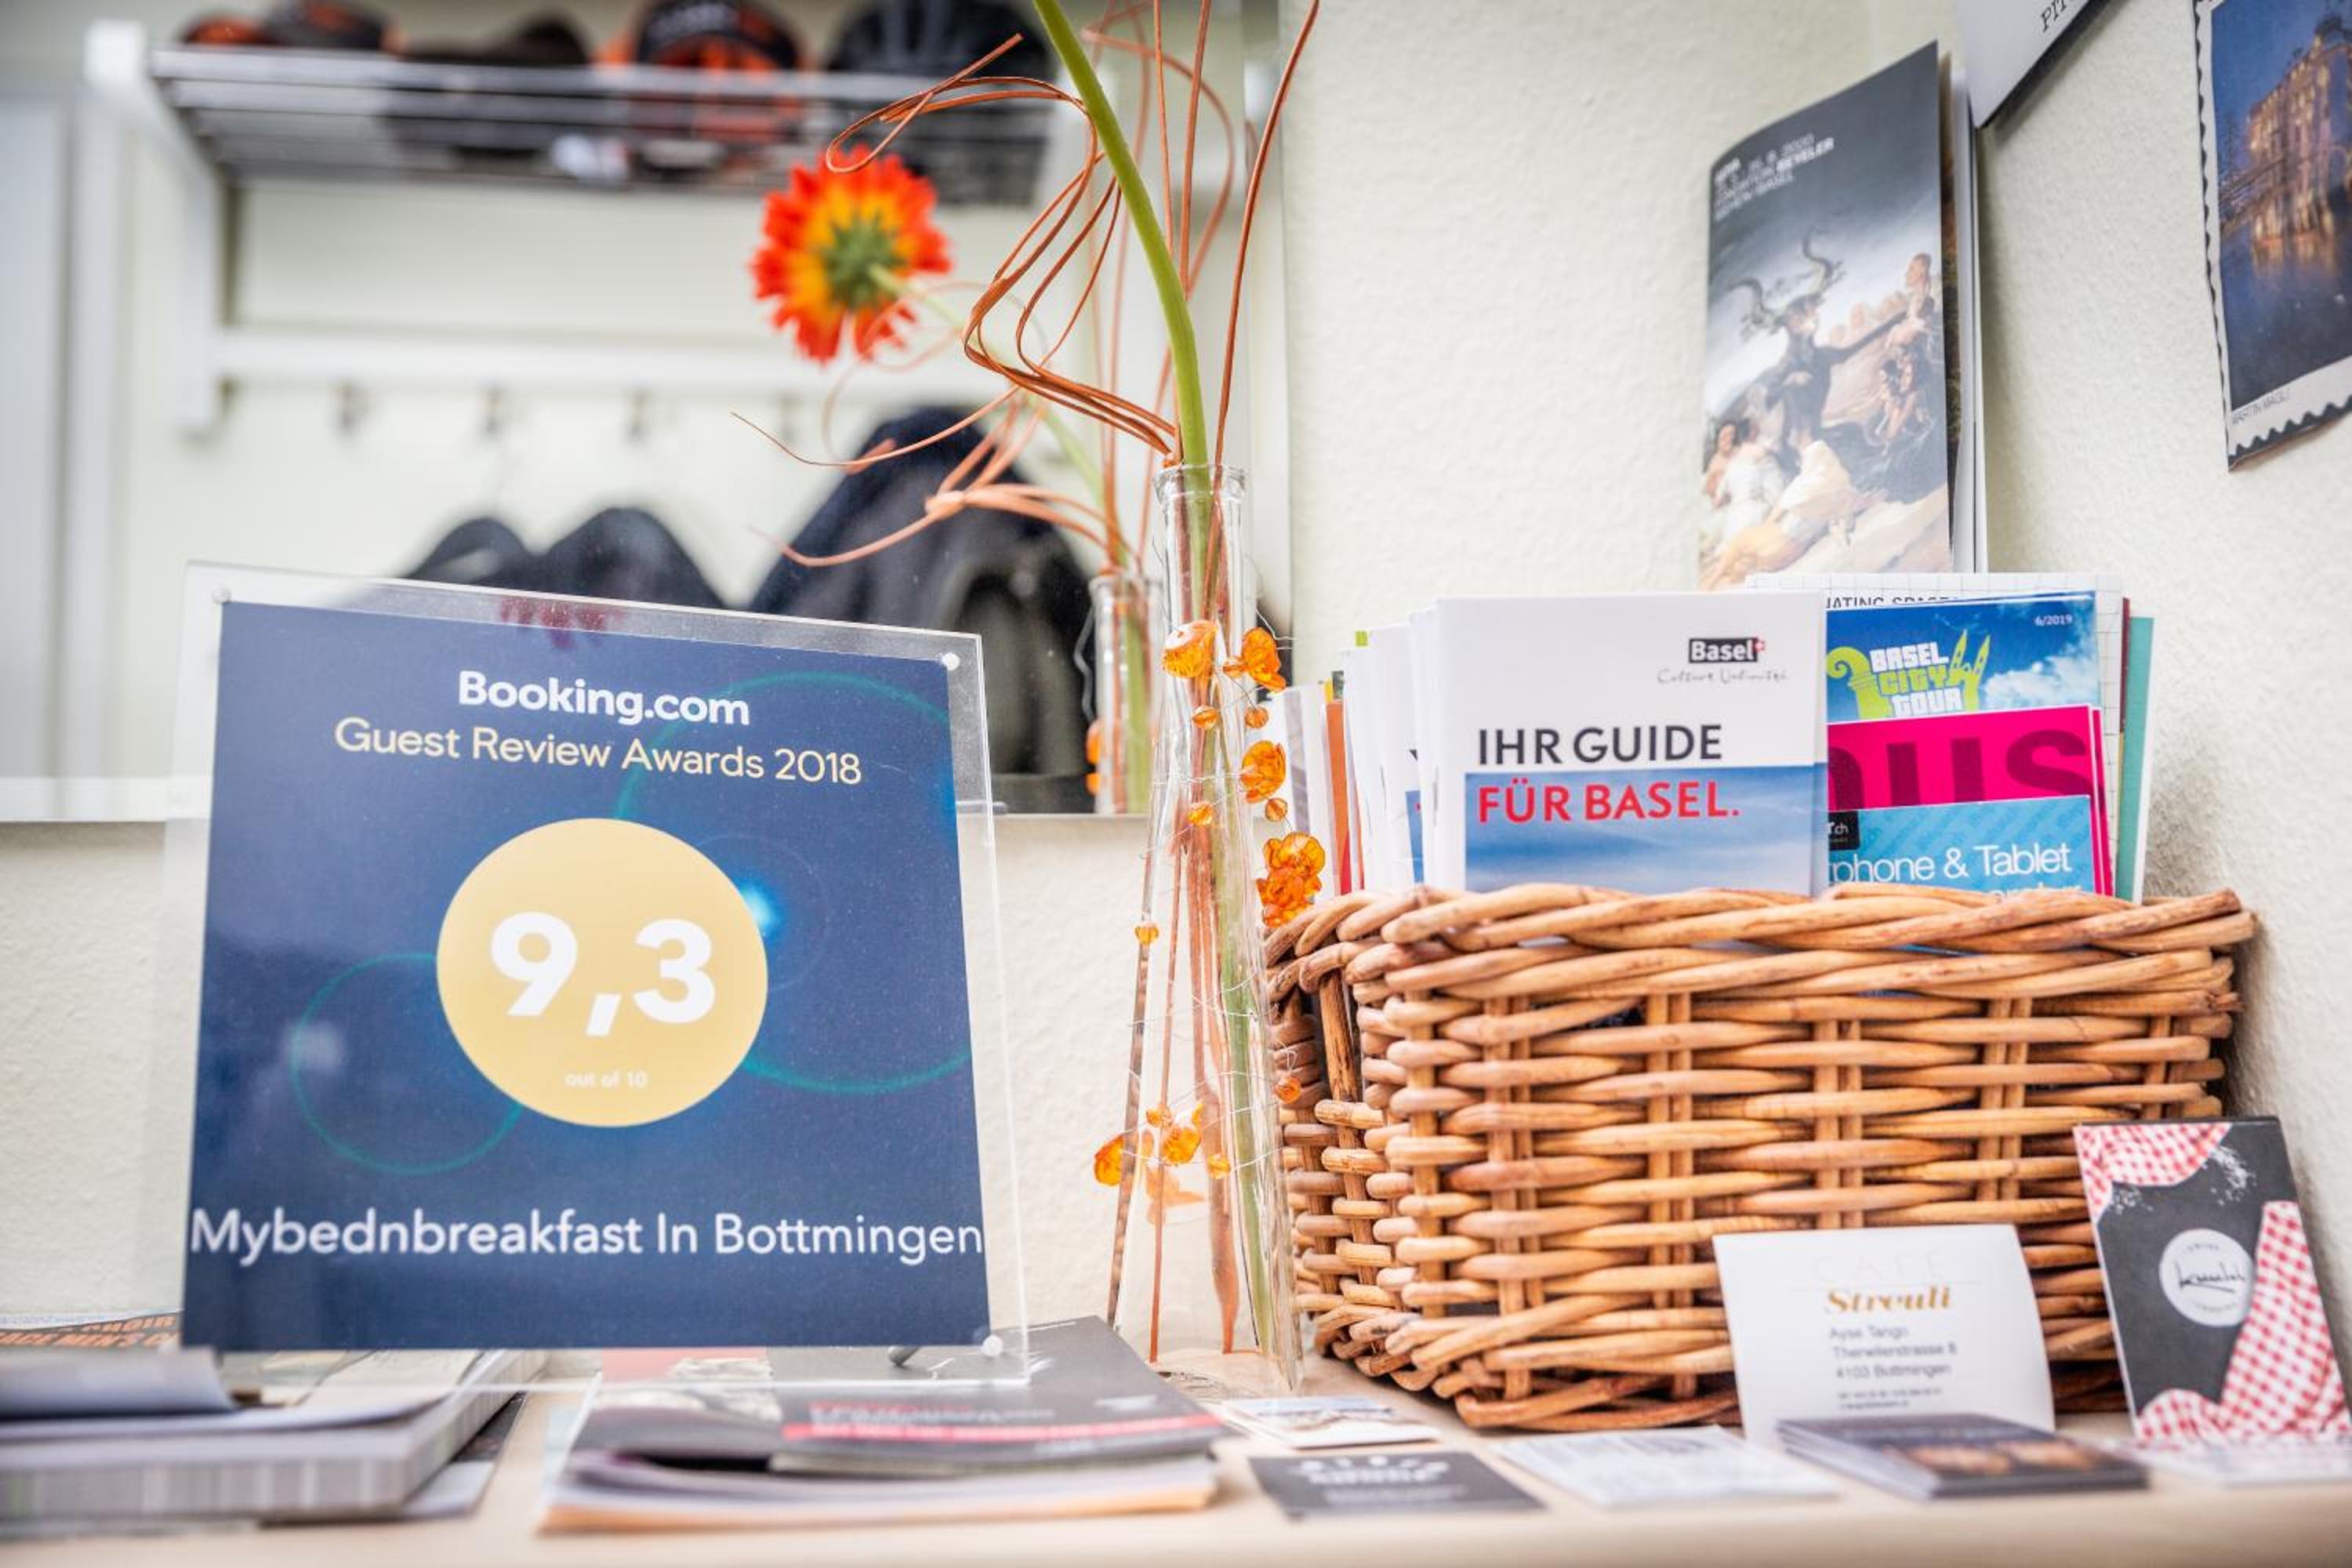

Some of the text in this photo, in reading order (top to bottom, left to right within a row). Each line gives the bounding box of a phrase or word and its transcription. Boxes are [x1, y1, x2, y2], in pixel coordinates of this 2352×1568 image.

[1690, 640, 1754, 662] Basel
[1870, 641, 1949, 673] BASEL
[457, 670, 750, 725] Booking.com
[1878, 664, 1951, 695] CITY
[1891, 687, 1961, 717] TOUR
[334, 717, 862, 784] Guest Review Awards 2018
[1479, 724, 1722, 765] IHR GUIDE
[1479, 778, 1740, 823] FÜR BASEL.
[1828, 843, 2074, 883] phone & Tablet
[491, 912, 715, 1036] 9,3
[564, 1071, 647, 1087] out of 10
[191, 1207, 984, 1267] Mybednbreakfast In Bottmingen
